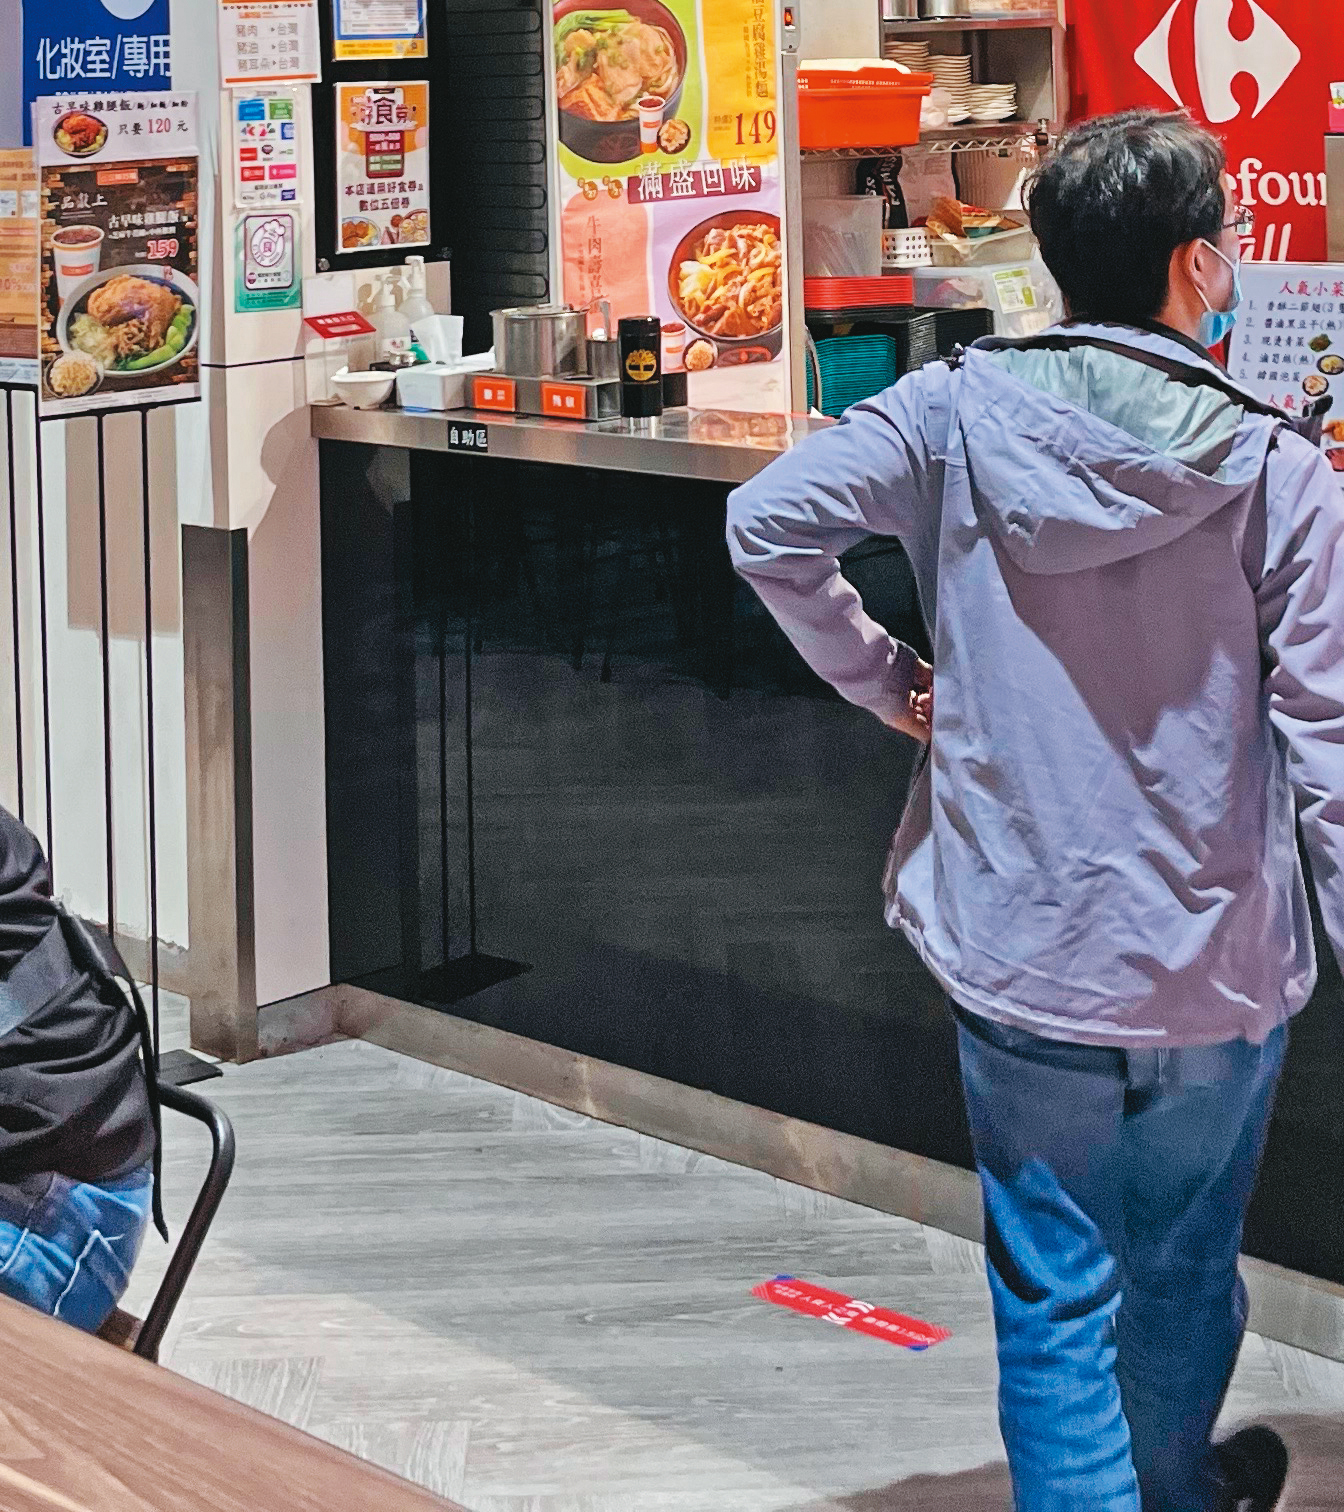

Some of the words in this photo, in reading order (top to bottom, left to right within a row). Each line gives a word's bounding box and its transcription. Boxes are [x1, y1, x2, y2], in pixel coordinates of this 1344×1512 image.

[147, 118, 172, 134] 120
[176, 120, 189, 133] 元
[735, 110, 777, 145] 149
[147, 238, 180, 260] 159
[449, 426, 488, 448] 自助區
